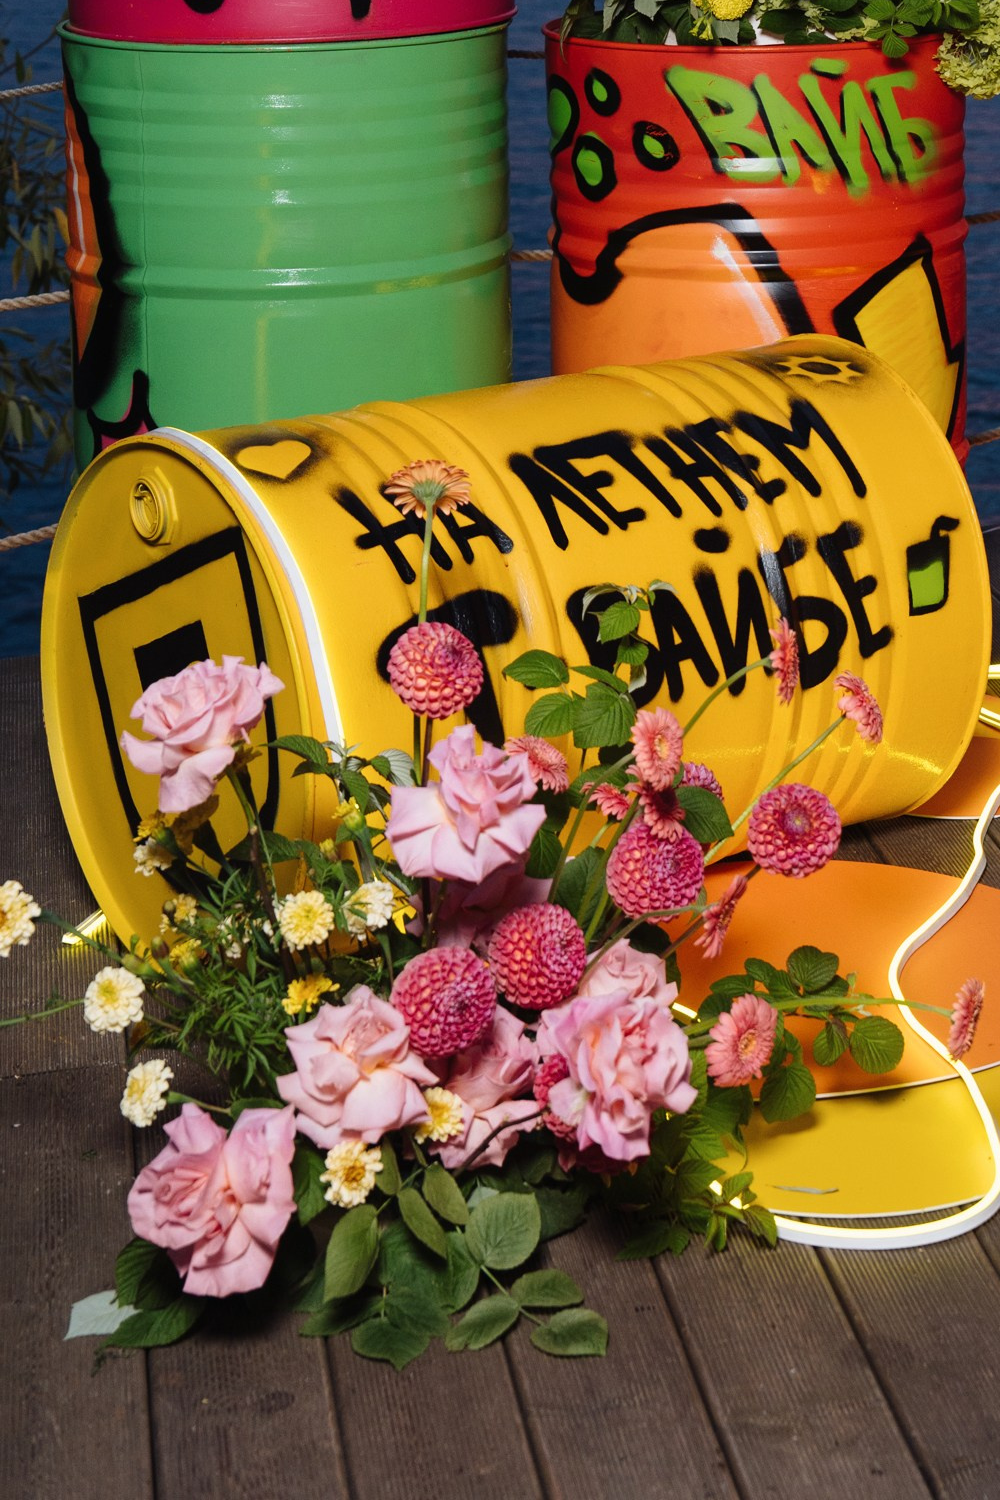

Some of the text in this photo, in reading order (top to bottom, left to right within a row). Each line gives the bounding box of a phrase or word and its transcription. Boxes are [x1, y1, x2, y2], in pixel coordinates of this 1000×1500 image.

[664, 57, 940, 198] ВАЙБ
[332, 397, 867, 585] НА ЛЕТНЕМ
